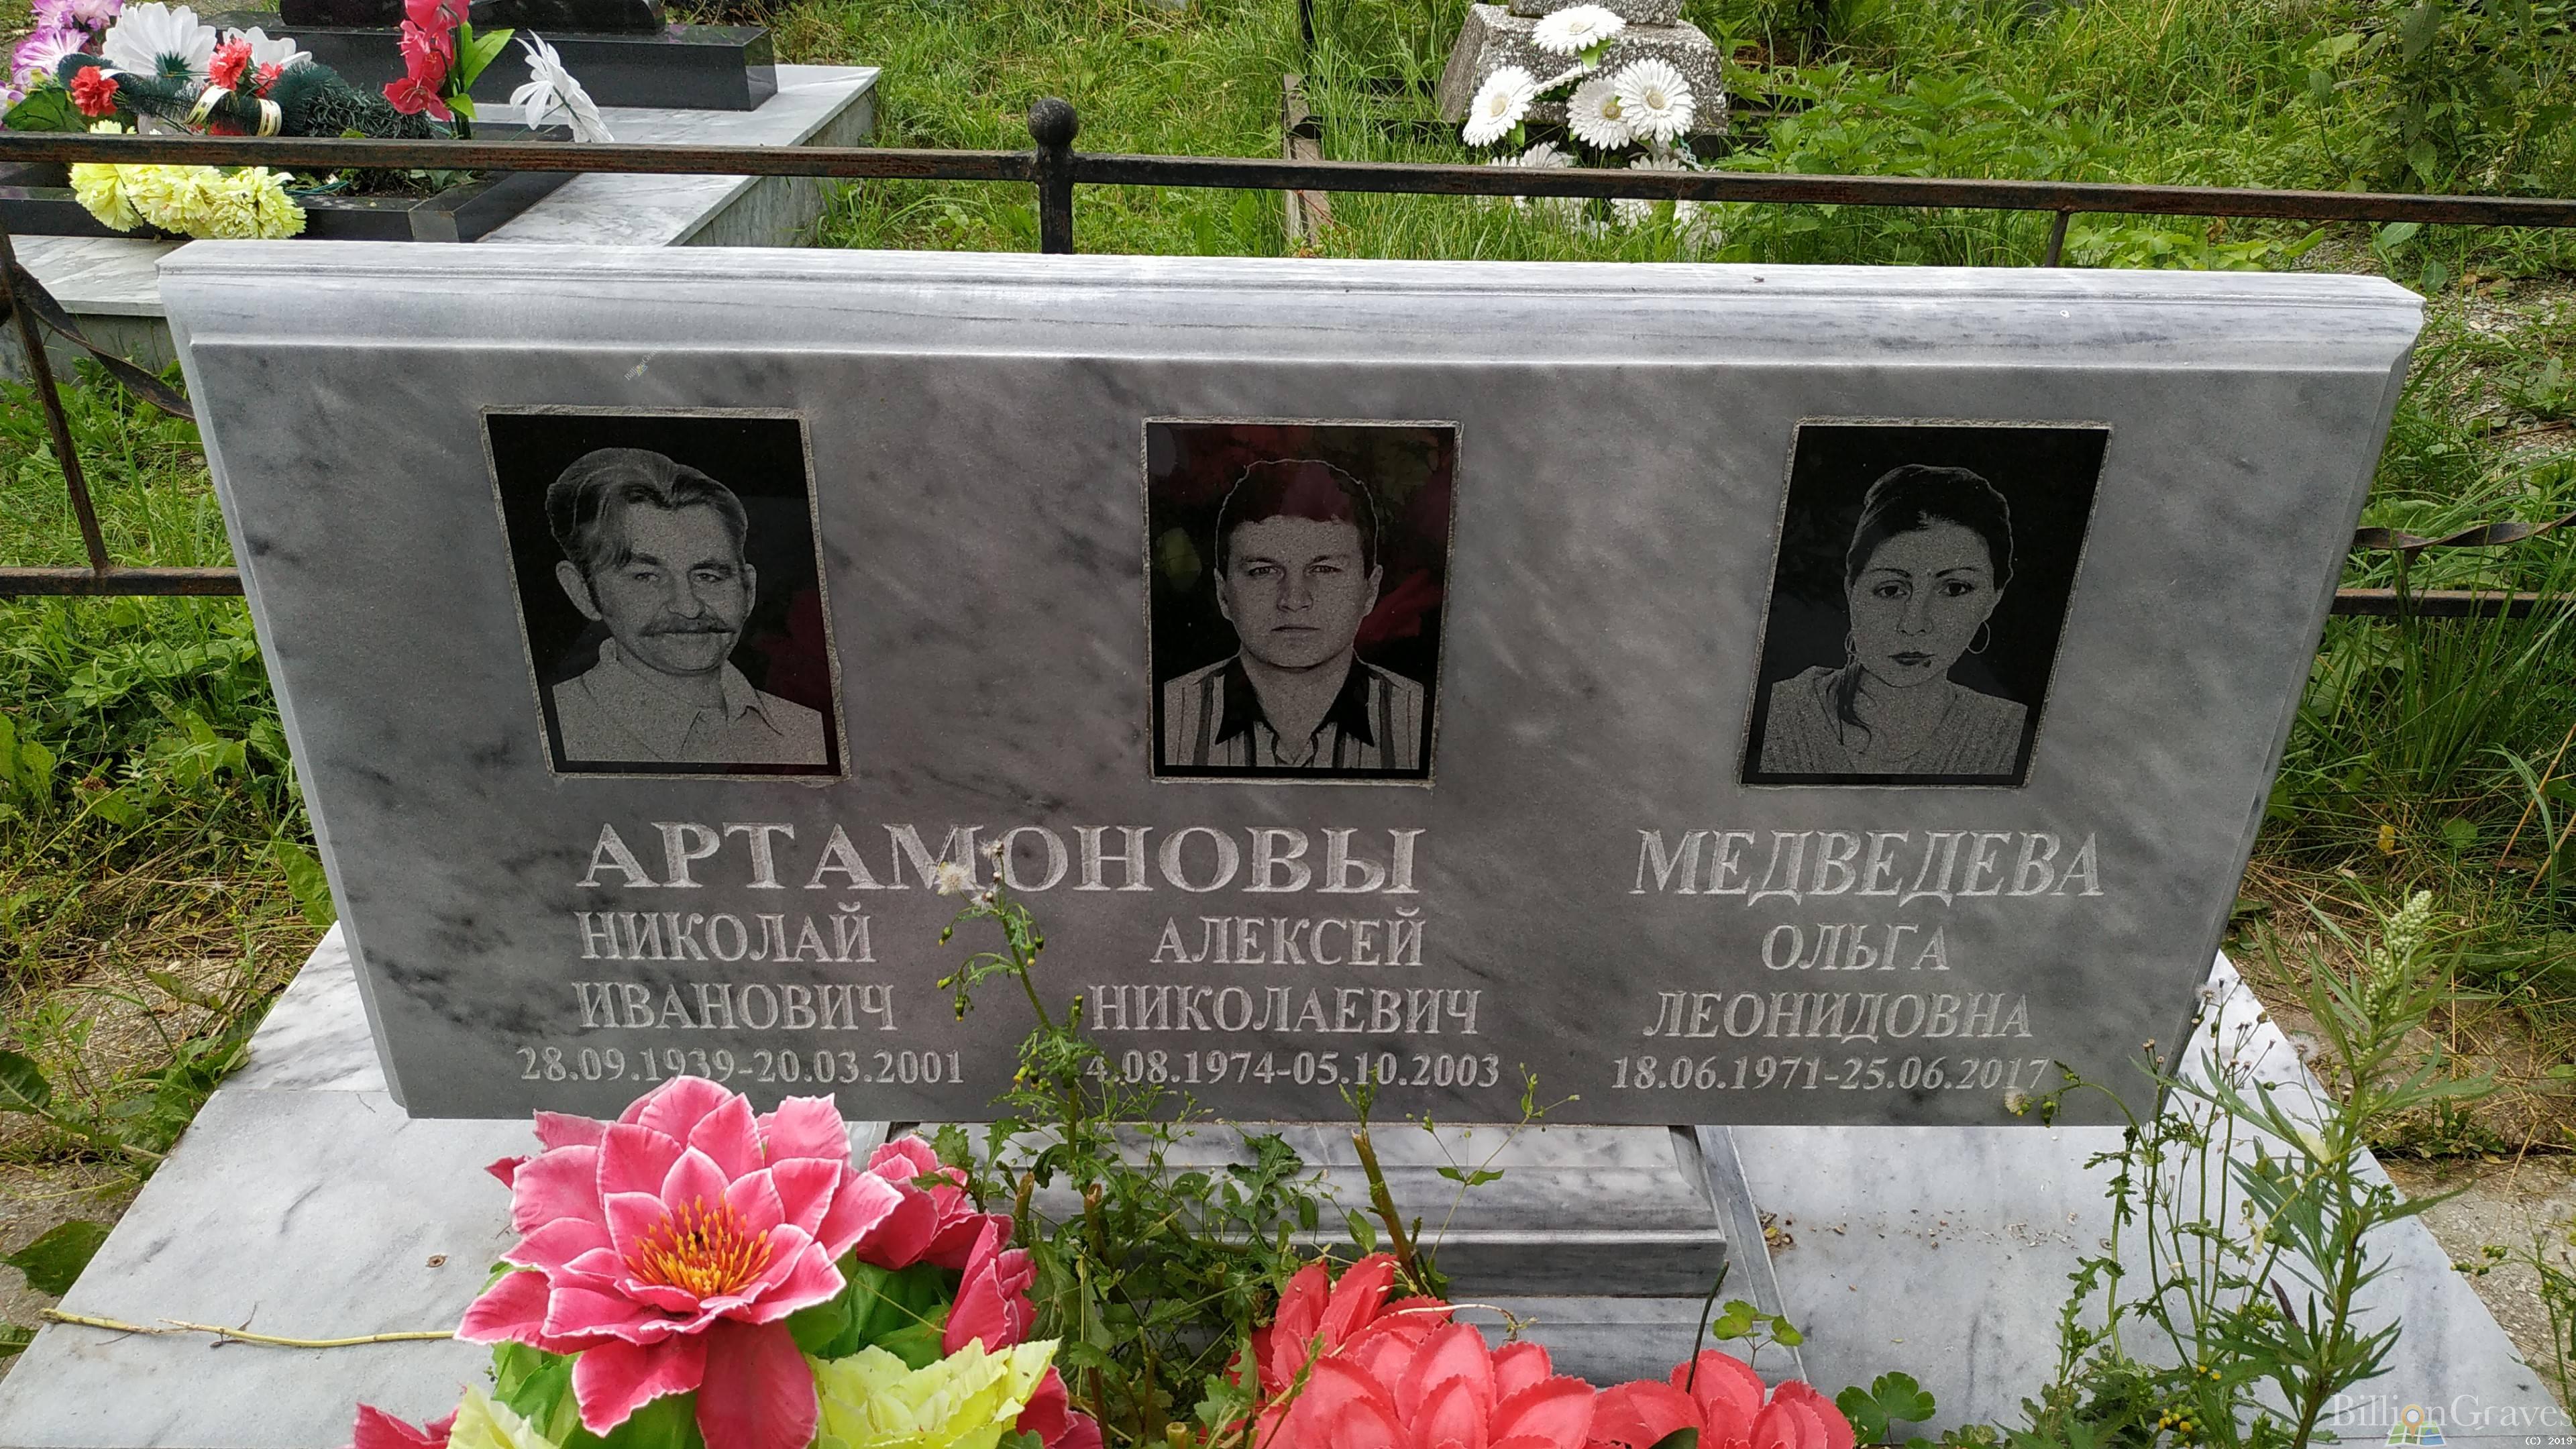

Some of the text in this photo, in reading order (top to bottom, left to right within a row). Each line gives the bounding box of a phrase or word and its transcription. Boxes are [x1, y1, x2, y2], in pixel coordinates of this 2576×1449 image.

[576, 821, 1426, 894] АРТАМОНОВЫ
[1628, 828, 2105, 907] МЕДВЕДЕВА
[572, 901, 877, 963] НИКОЛАЙ
[1149, 906, 1426, 967] АЛЕКСЕЙ
[1760, 923, 1950, 971] ОЛЬГА
[571, 981, 899, 1031] ИВАНОВИЧ
[1087, 983, 1482, 1035] НИКОЛАЕВИЧ
[1642, 991, 2033, 1044] ЛЕОНИДОВНА
[516, 1045, 965, 1085] 28.09.1939-20.03.2001
[1072, 1049, 1501, 1089] 4.08.1974-05.10.2003
[1610, 1055, 2050, 1091] 18.06.1971-25.06.2017
